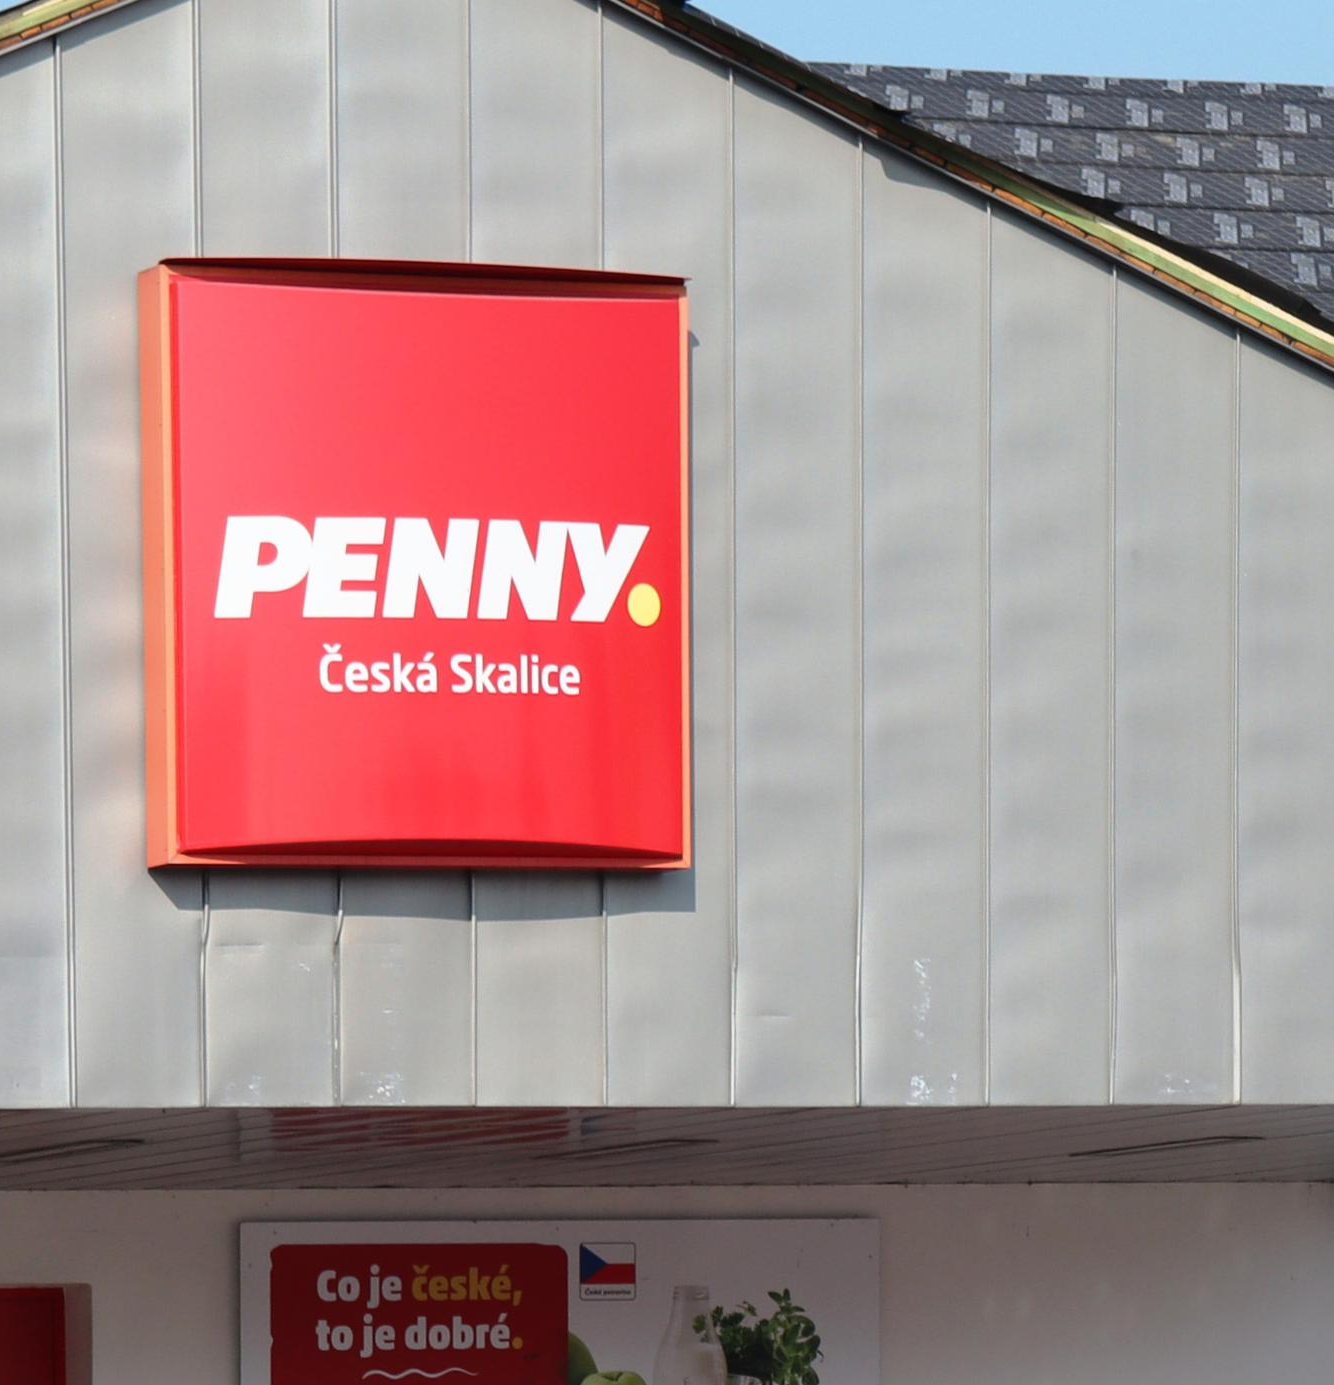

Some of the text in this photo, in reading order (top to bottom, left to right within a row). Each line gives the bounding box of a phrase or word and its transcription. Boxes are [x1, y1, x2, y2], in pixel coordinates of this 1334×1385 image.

[214, 515, 661, 627] PENNY.
[319, 643, 581, 696] Česká Skalice
[317, 1264, 522, 1309] Co je české,
[316, 1312, 524, 1358] to je dobré.
